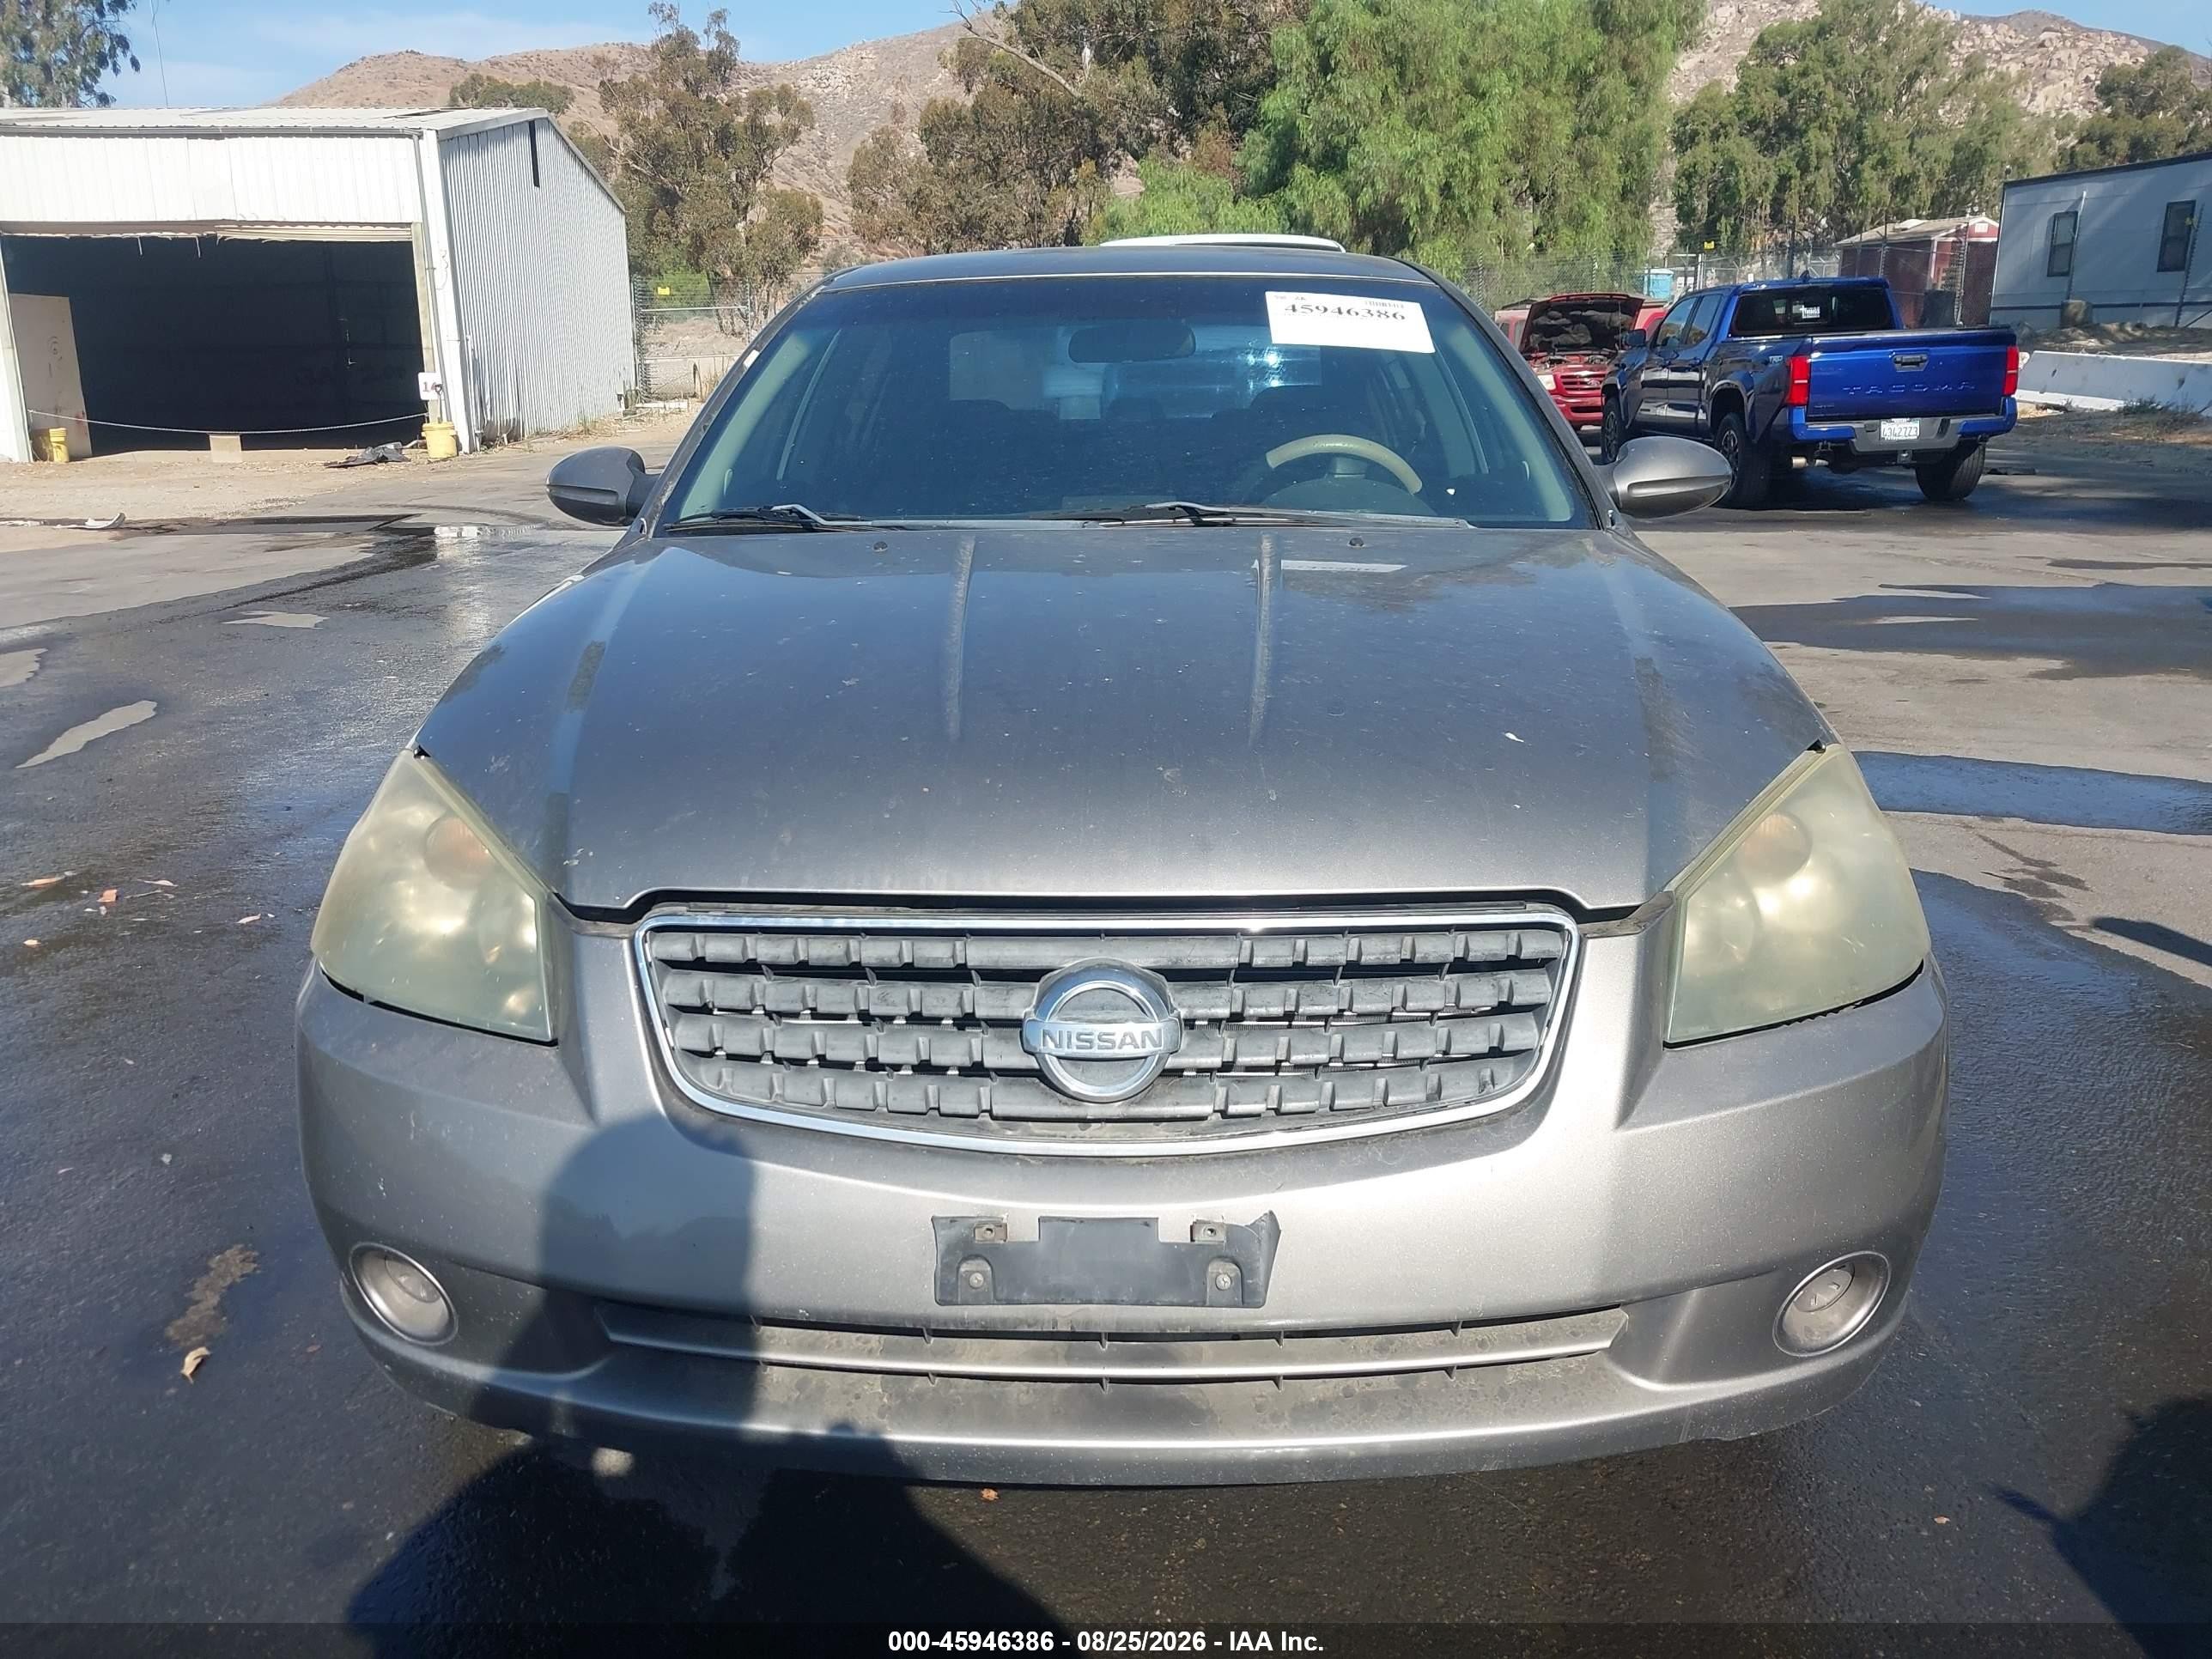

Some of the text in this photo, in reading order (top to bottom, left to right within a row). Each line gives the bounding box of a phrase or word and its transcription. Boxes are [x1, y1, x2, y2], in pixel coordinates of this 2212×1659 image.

[1285, 303, 1407, 321] 45946386
[1843, 380, 1975, 396] TACOMA
[1041, 1028, 1164, 1051] NISSAN
